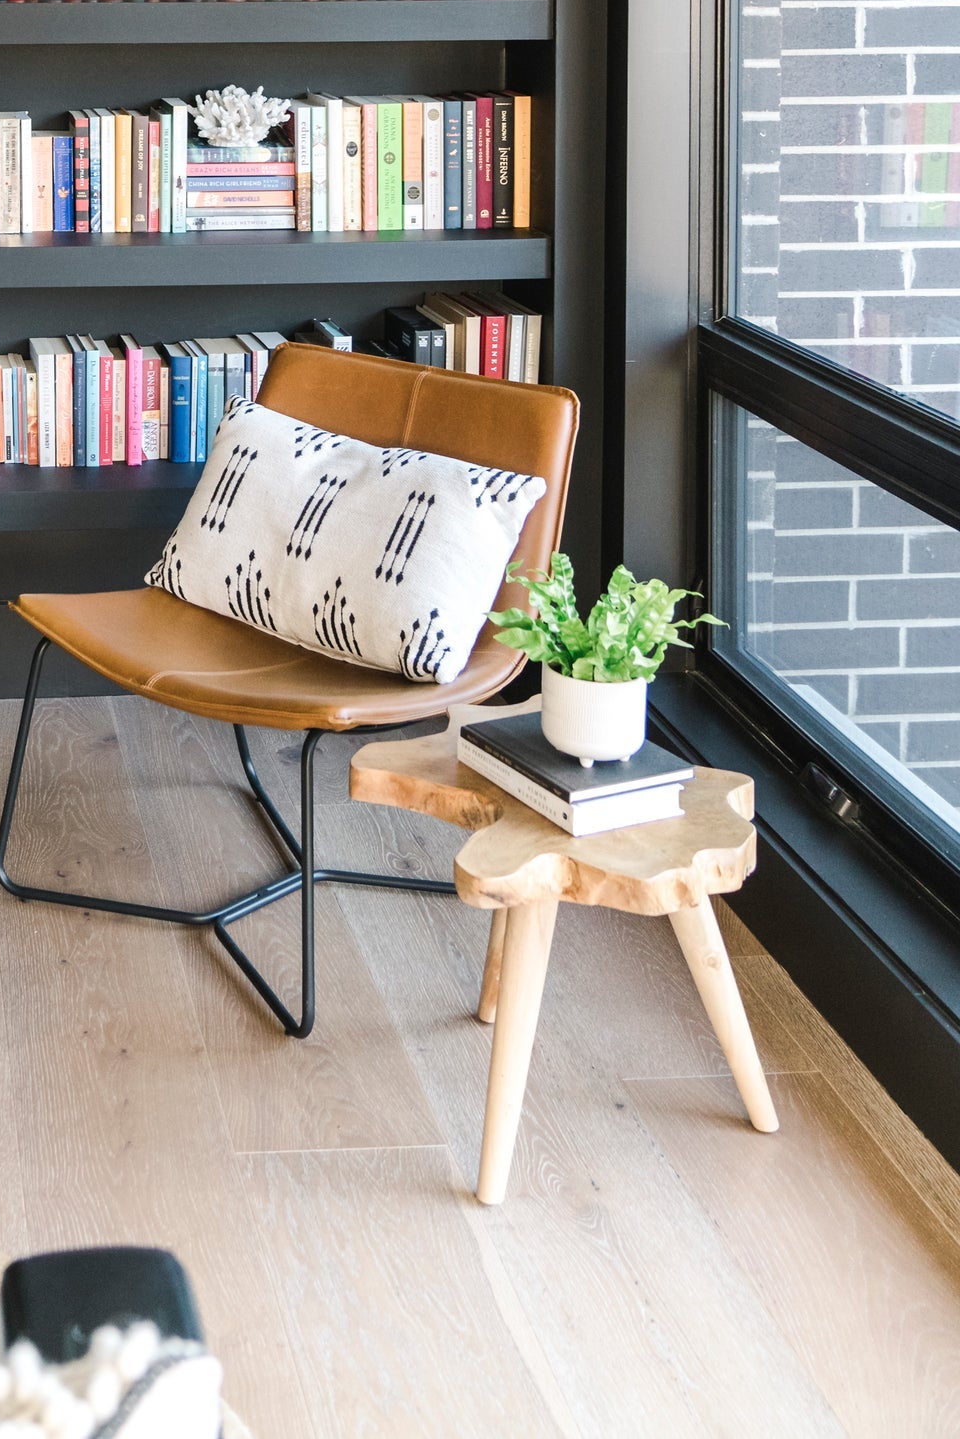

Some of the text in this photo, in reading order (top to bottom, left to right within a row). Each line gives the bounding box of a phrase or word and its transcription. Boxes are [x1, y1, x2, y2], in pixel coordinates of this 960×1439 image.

[300, 121, 309, 166] educated
[390, 175, 395, 186] AN
[499, 147, 510, 185] INFERNO
[491, 323, 499, 372] JOURNEY
[147, 371, 155, 409] DAN BROWN
